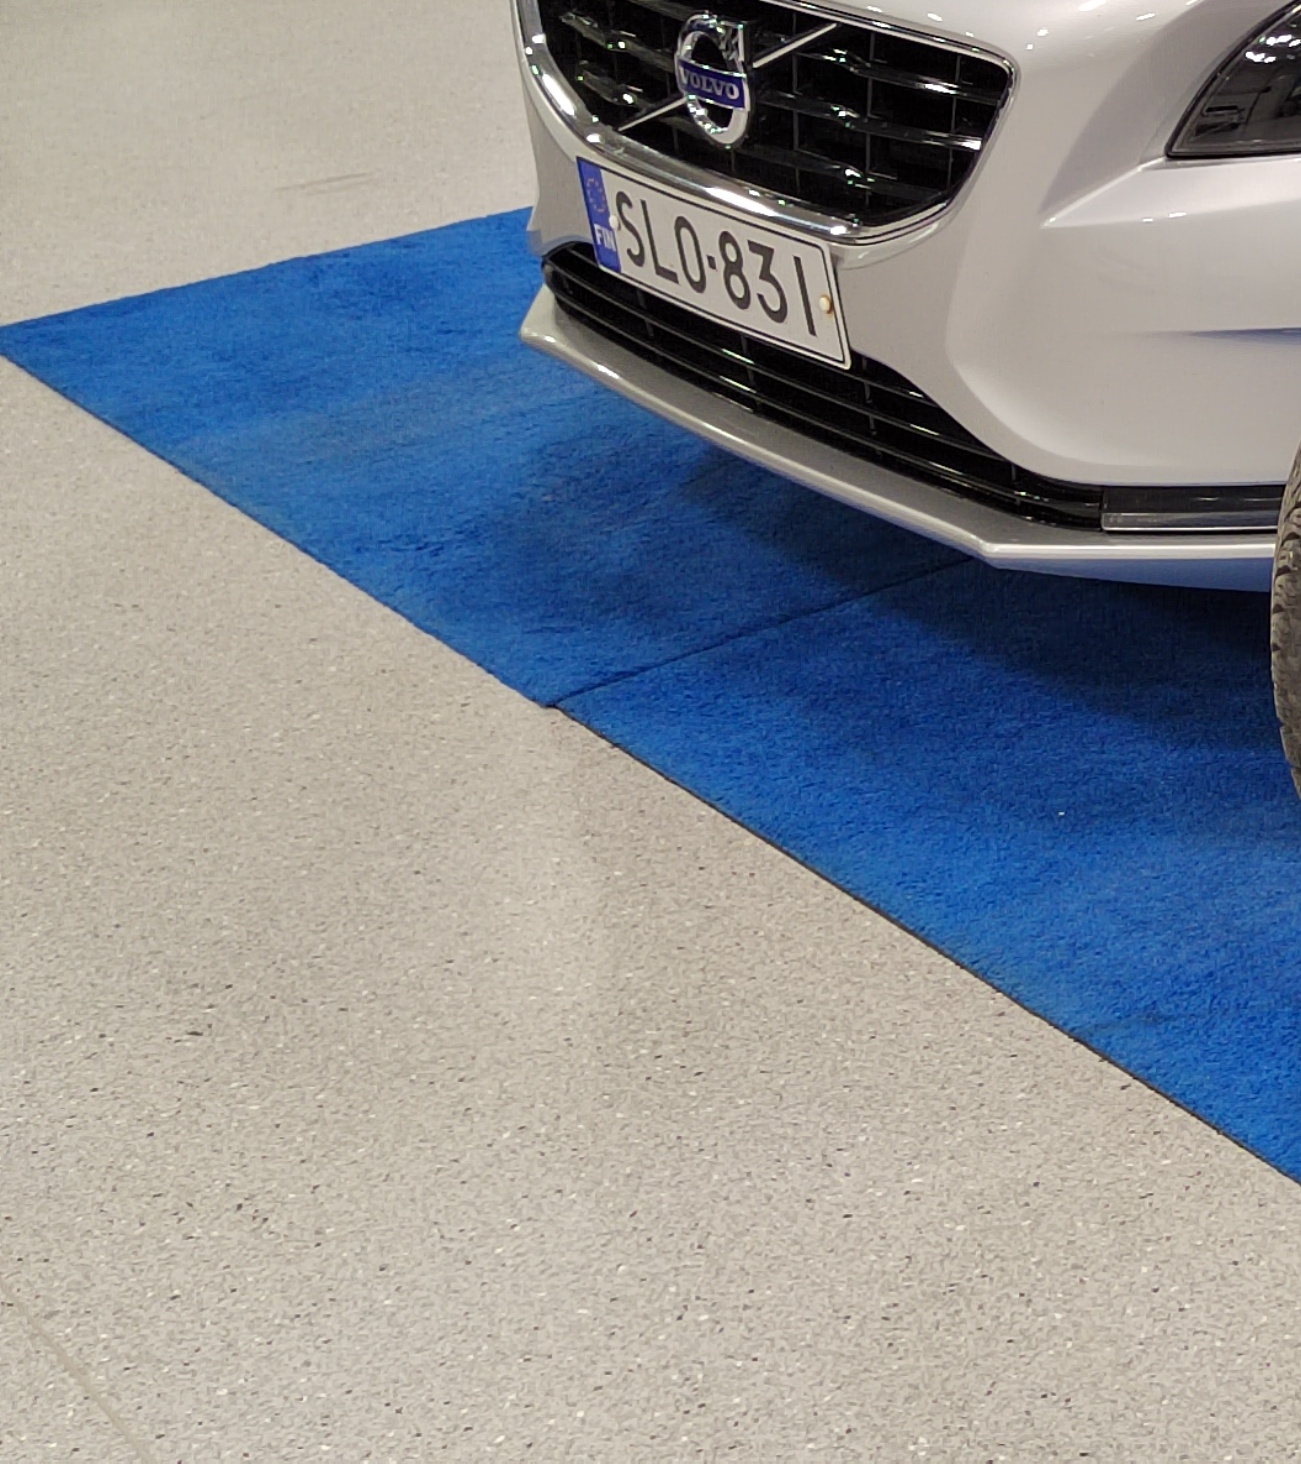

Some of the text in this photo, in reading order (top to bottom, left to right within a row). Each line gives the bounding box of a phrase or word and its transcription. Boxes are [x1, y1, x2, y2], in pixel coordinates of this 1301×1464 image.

[681, 70, 740, 102] VOLVO
[593, 190, 818, 337] FIN SLO-831
